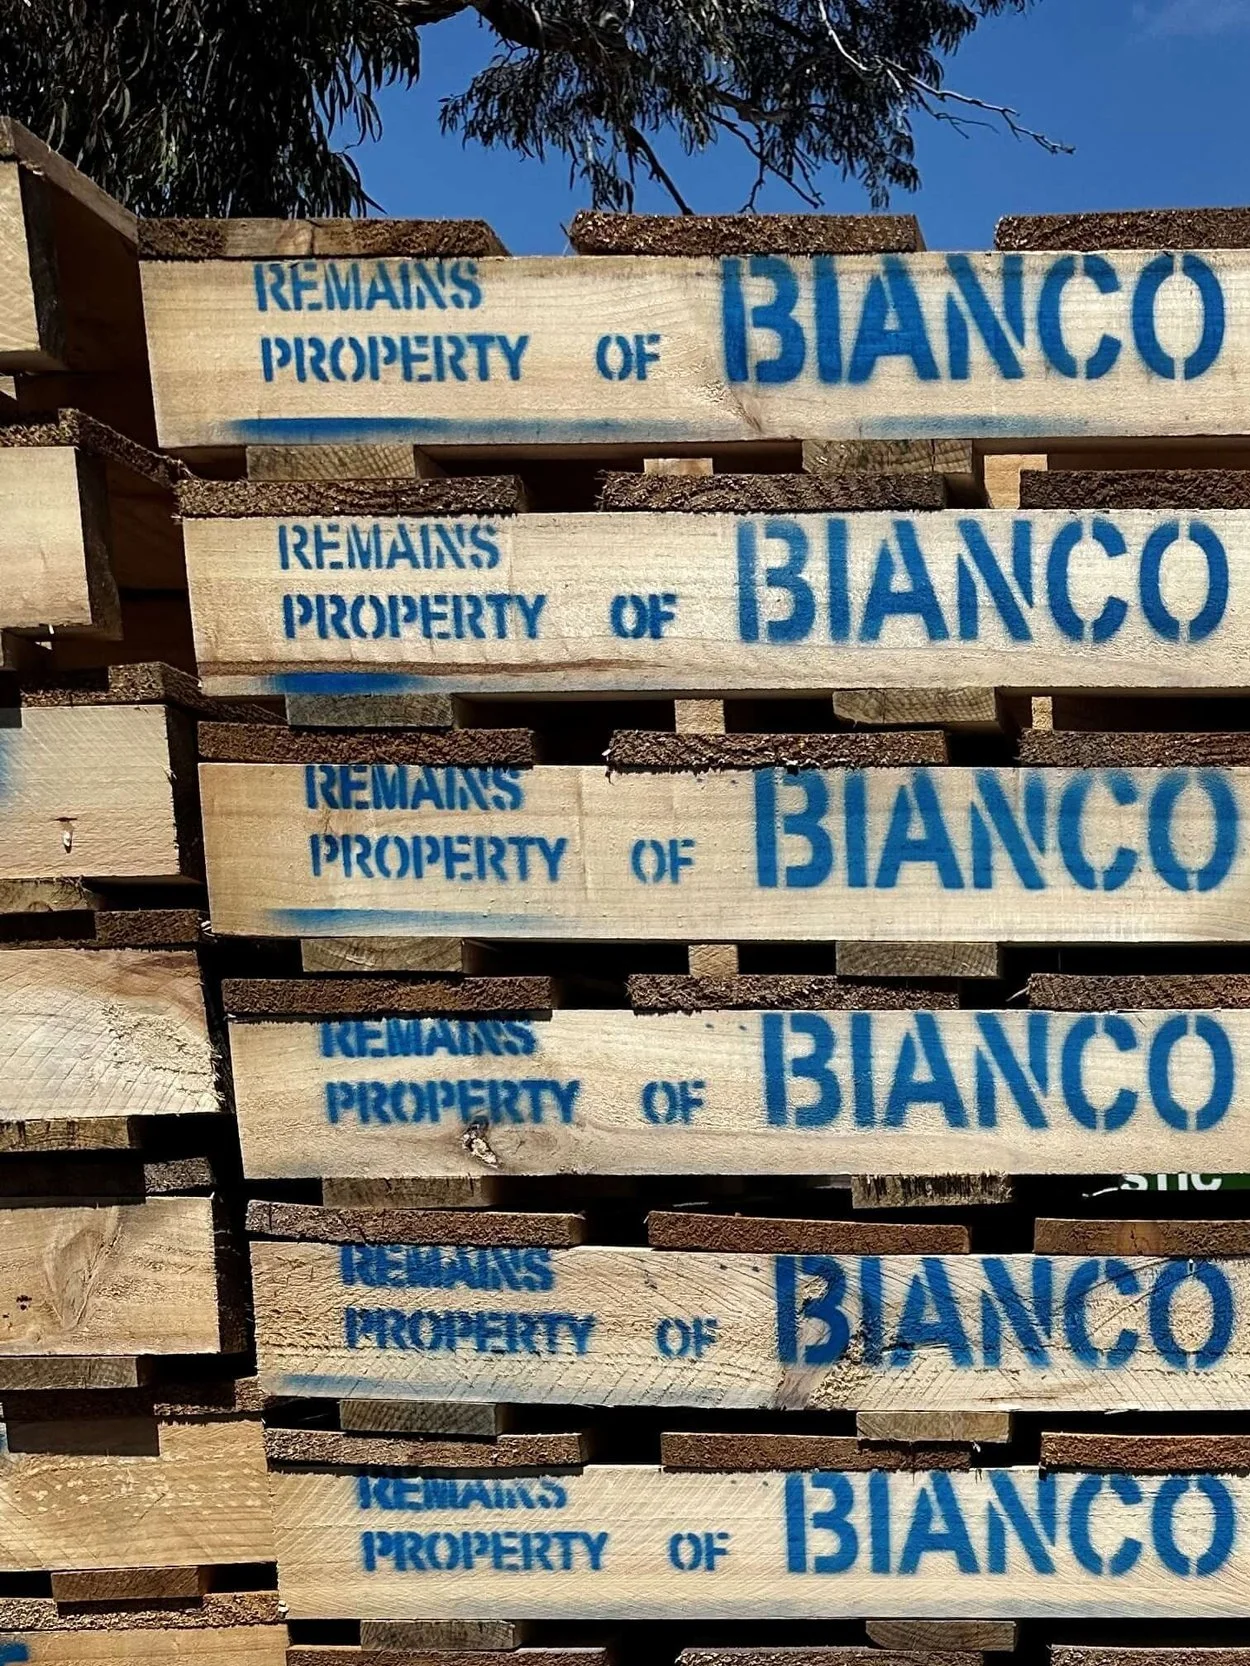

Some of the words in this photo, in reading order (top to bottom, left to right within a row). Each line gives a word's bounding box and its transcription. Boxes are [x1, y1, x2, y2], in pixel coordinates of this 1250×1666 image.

[254, 258, 482, 311] REMAINS
[262, 333, 528, 380] PROPERTY
[596, 335, 658, 379] OF
[721, 254, 1226, 384] BIANCO
[279, 525, 500, 568] REMAINS
[284, 593, 545, 639] PROPERTY
[610, 594, 676, 639] OF
[737, 518, 1229, 644] BIANCO
[306, 765, 523, 809] REMAINS
[311, 835, 566, 880] PROPERTY
[631, 838, 696, 882] OF
[755, 768, 1240, 892] BIANCO
[320, 1018, 536, 1058] REMAINS
[326, 1079, 579, 1123] PROPERTY
[642, 1082, 702, 1122] OF
[762, 1012, 1236, 1131] BIANCO
[345, 1308, 596, 1355] PROPERTY
[656, 1316, 718, 1357] OF
[775, 1255, 1234, 1369] BIANCO
[361, 1531, 608, 1571] PROPERTY
[669, 1532, 729, 1570] OF
[784, 1470, 1237, 1576] BIANCO
